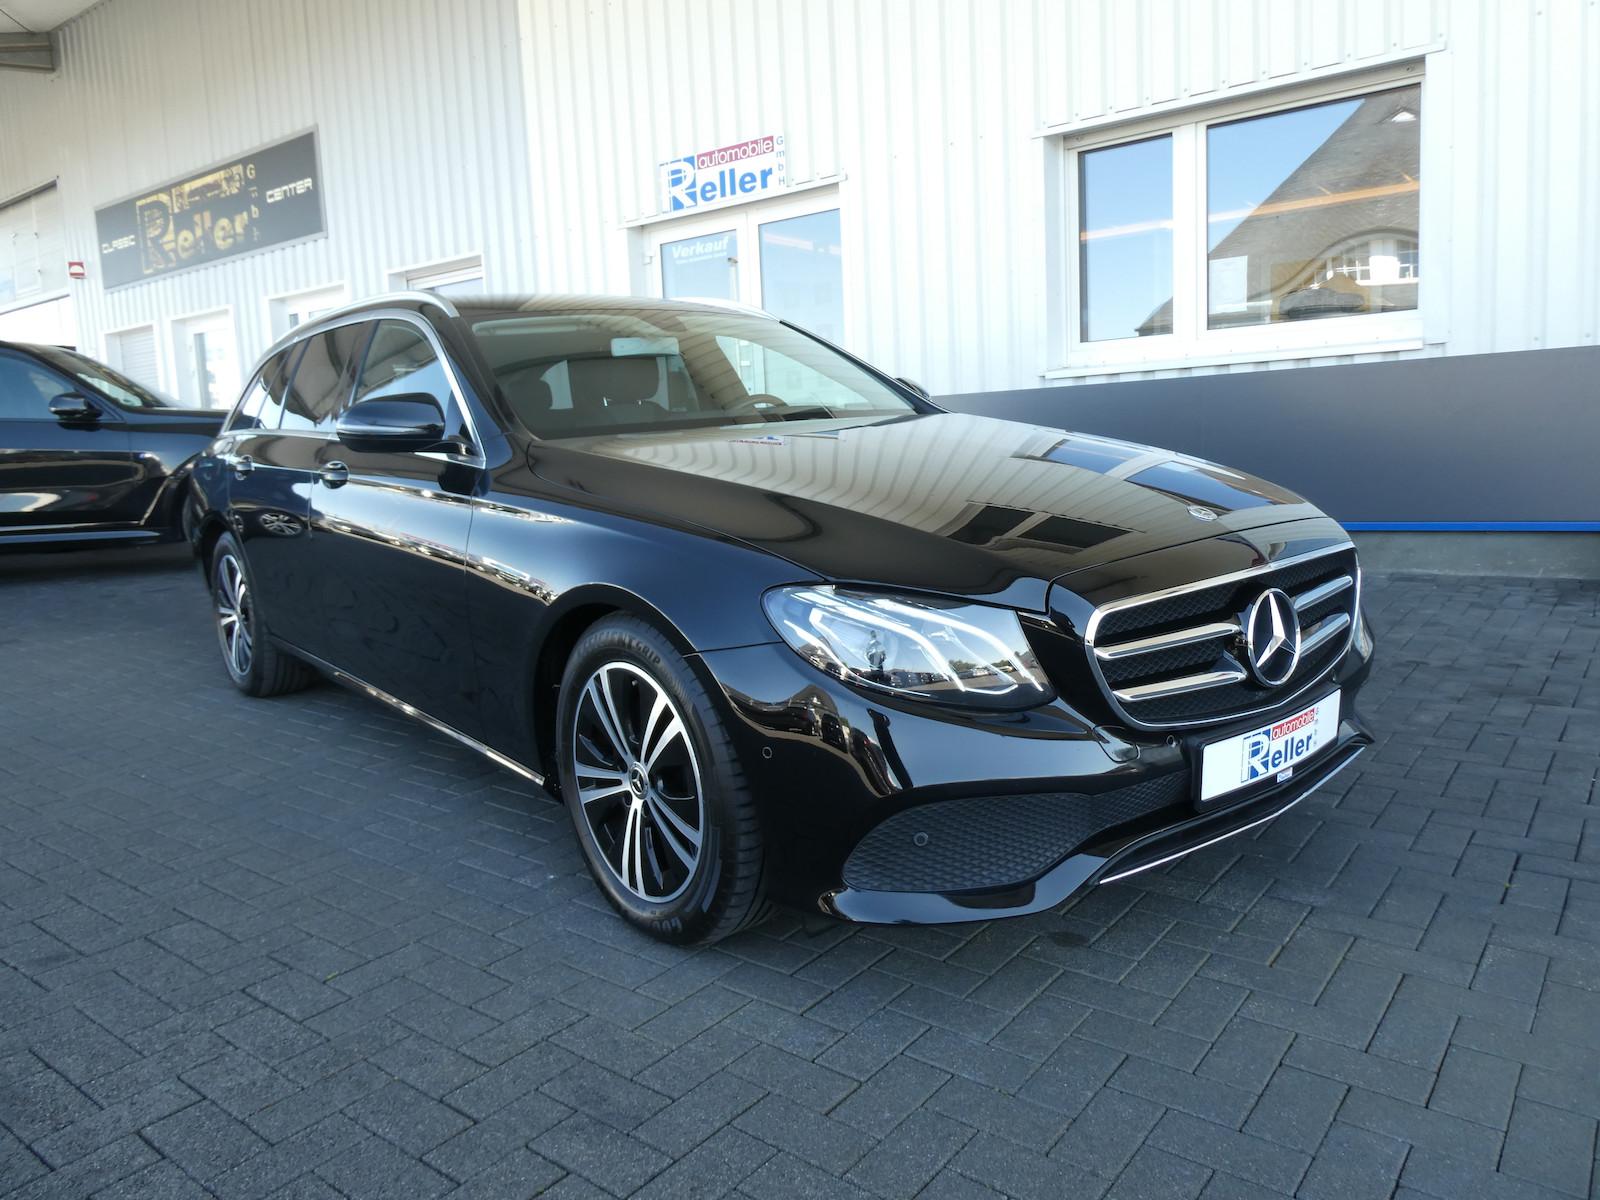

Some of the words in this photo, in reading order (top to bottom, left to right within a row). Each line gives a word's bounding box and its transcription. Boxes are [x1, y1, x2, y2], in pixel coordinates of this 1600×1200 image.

[698, 138, 774, 169] automobile
[776, 136, 785, 186] GmbH
[266, 177, 313, 203] CENTER
[660, 157, 774, 213] Reller
[672, 236, 729, 258] Verkauf
[1272, 709, 1315, 740] automobile
[1240, 728, 1313, 783] Reller
